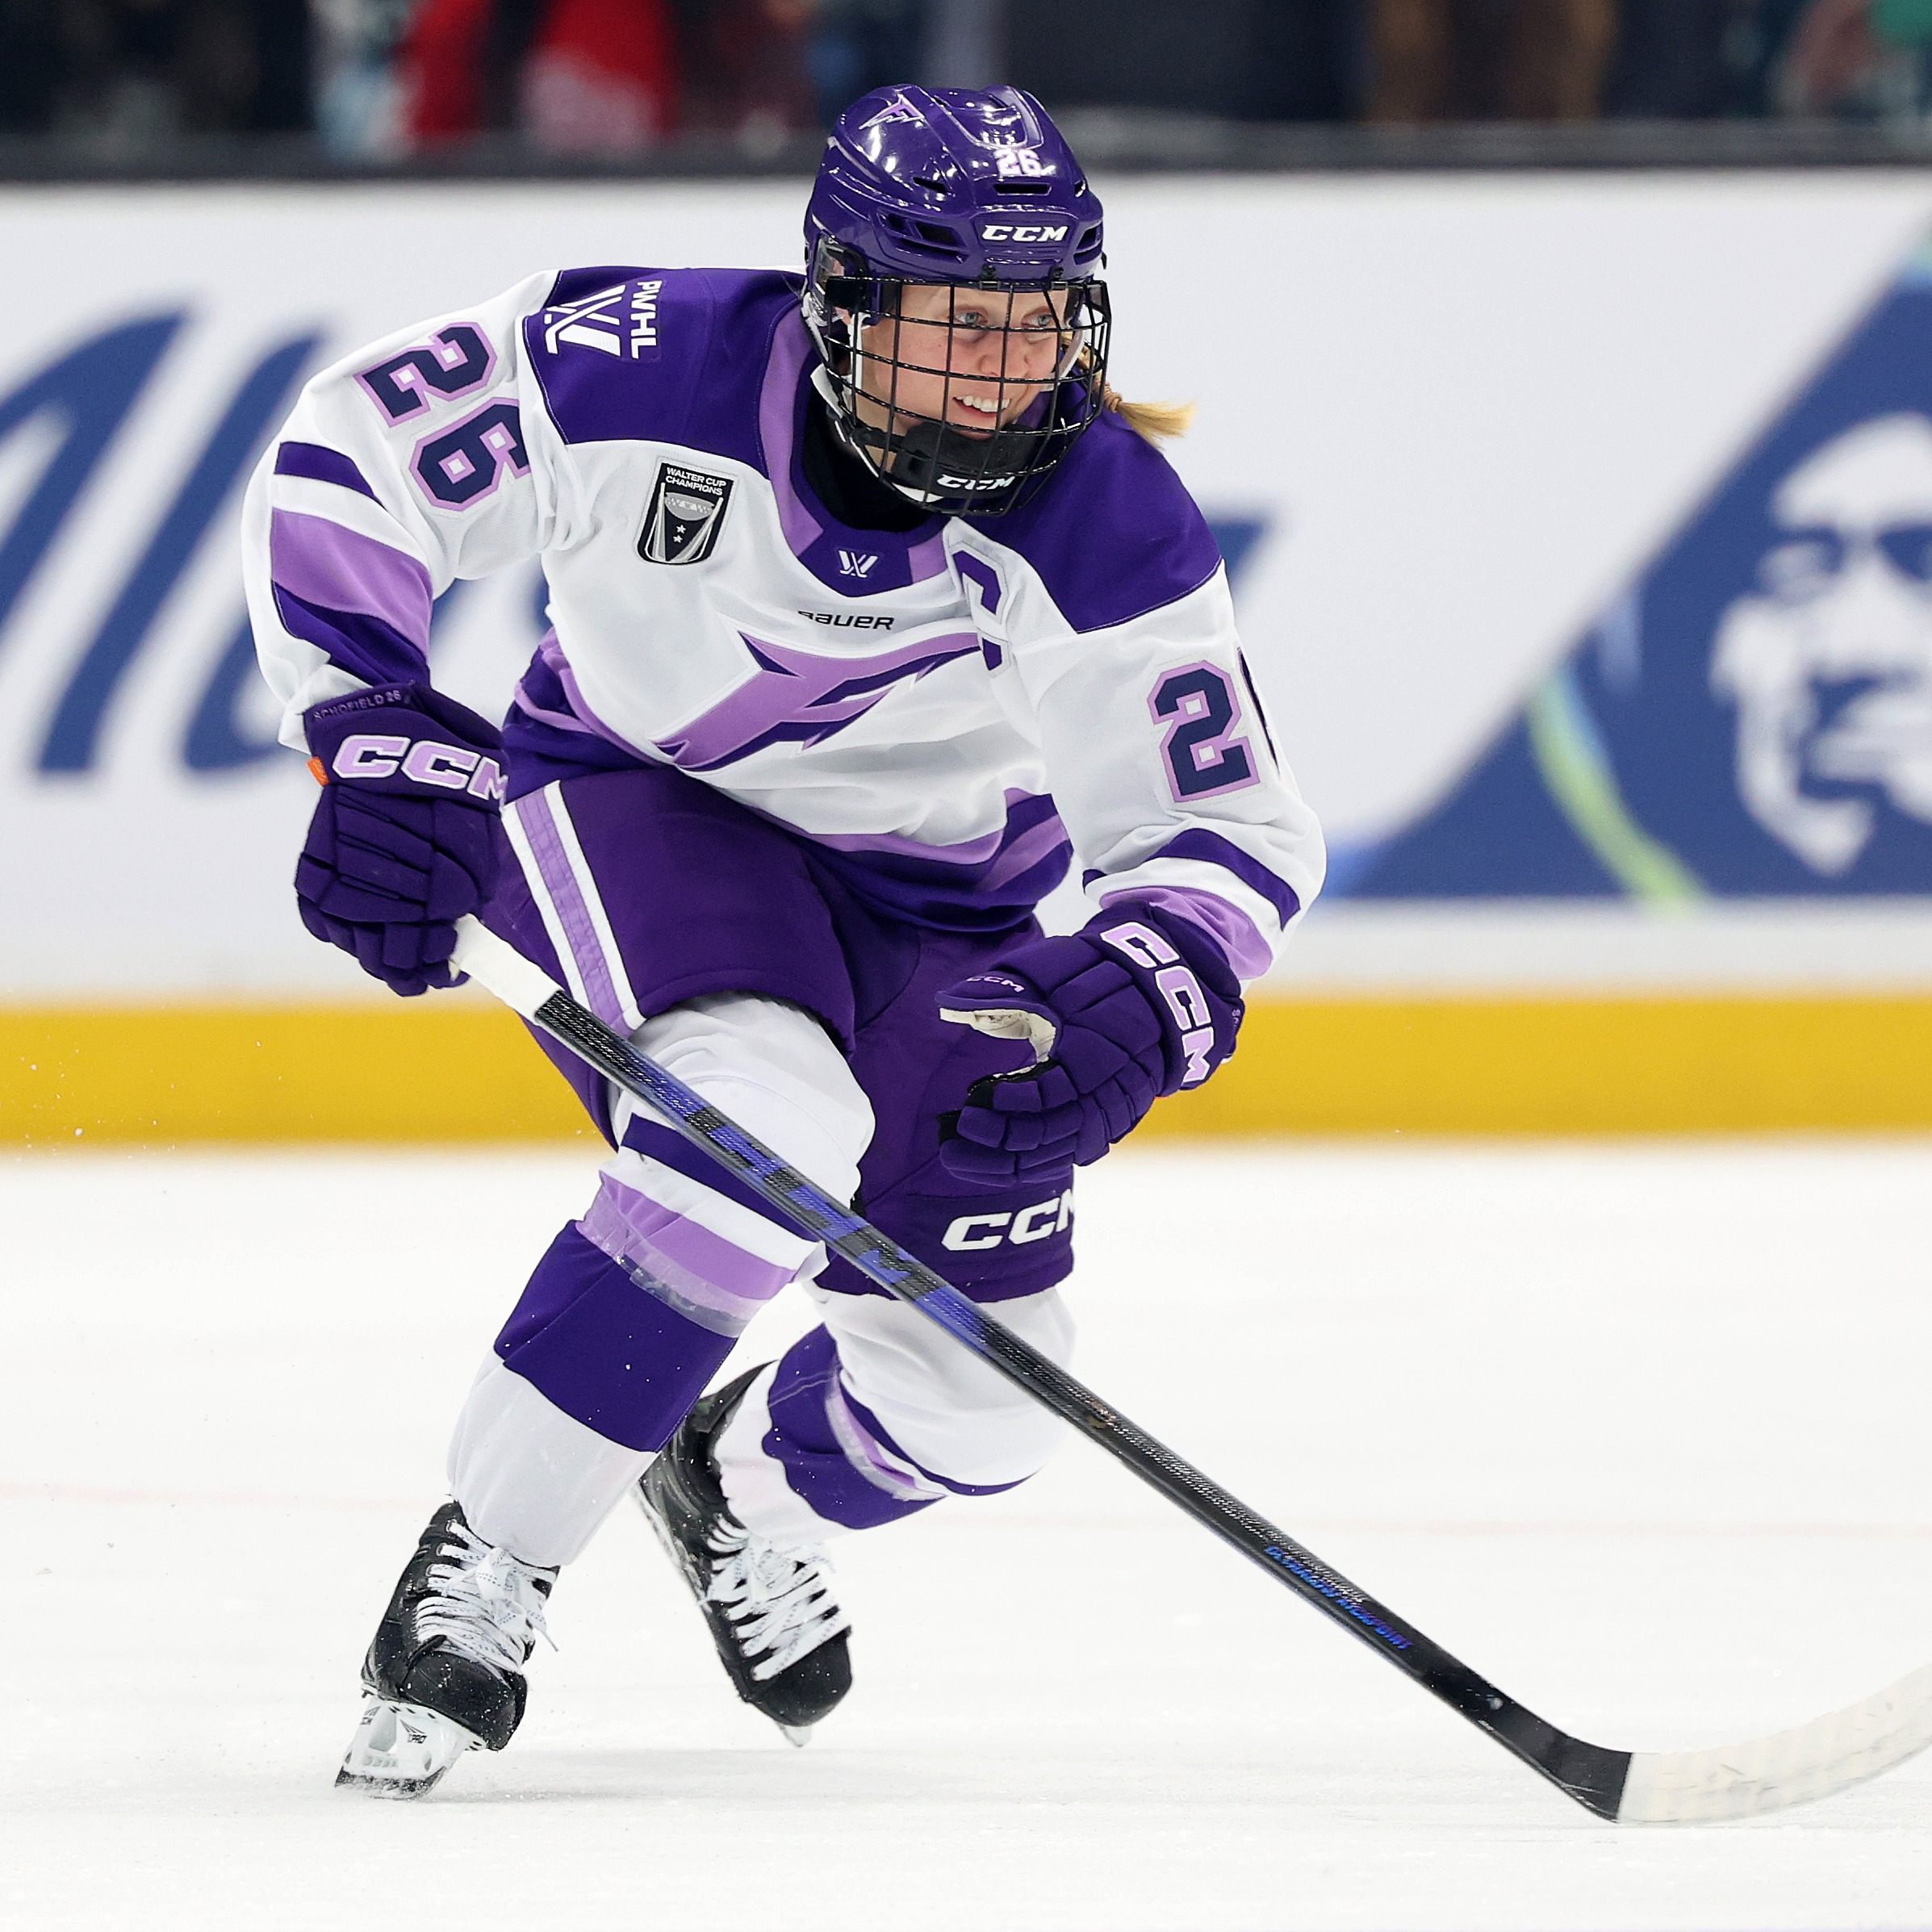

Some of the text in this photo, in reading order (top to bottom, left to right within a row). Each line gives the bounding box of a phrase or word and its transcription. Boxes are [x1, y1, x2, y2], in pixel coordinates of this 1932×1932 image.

[993, 148, 1042, 178] 26
[981, 224, 1068, 242] CCM
[630, 280, 663, 359] PWHL
[353, 320, 532, 512] 26
[665, 475, 723, 496] CHAMPIONS
[667, 466, 727, 487] WALTER CUP
[936, 474, 1016, 491] CCM
[313, 694, 385, 720] SCHOFIELD
[332, 734, 508, 809] CCM
[966, 975, 1025, 993] CCM
[1100, 921, 1215, 1084] CCM
